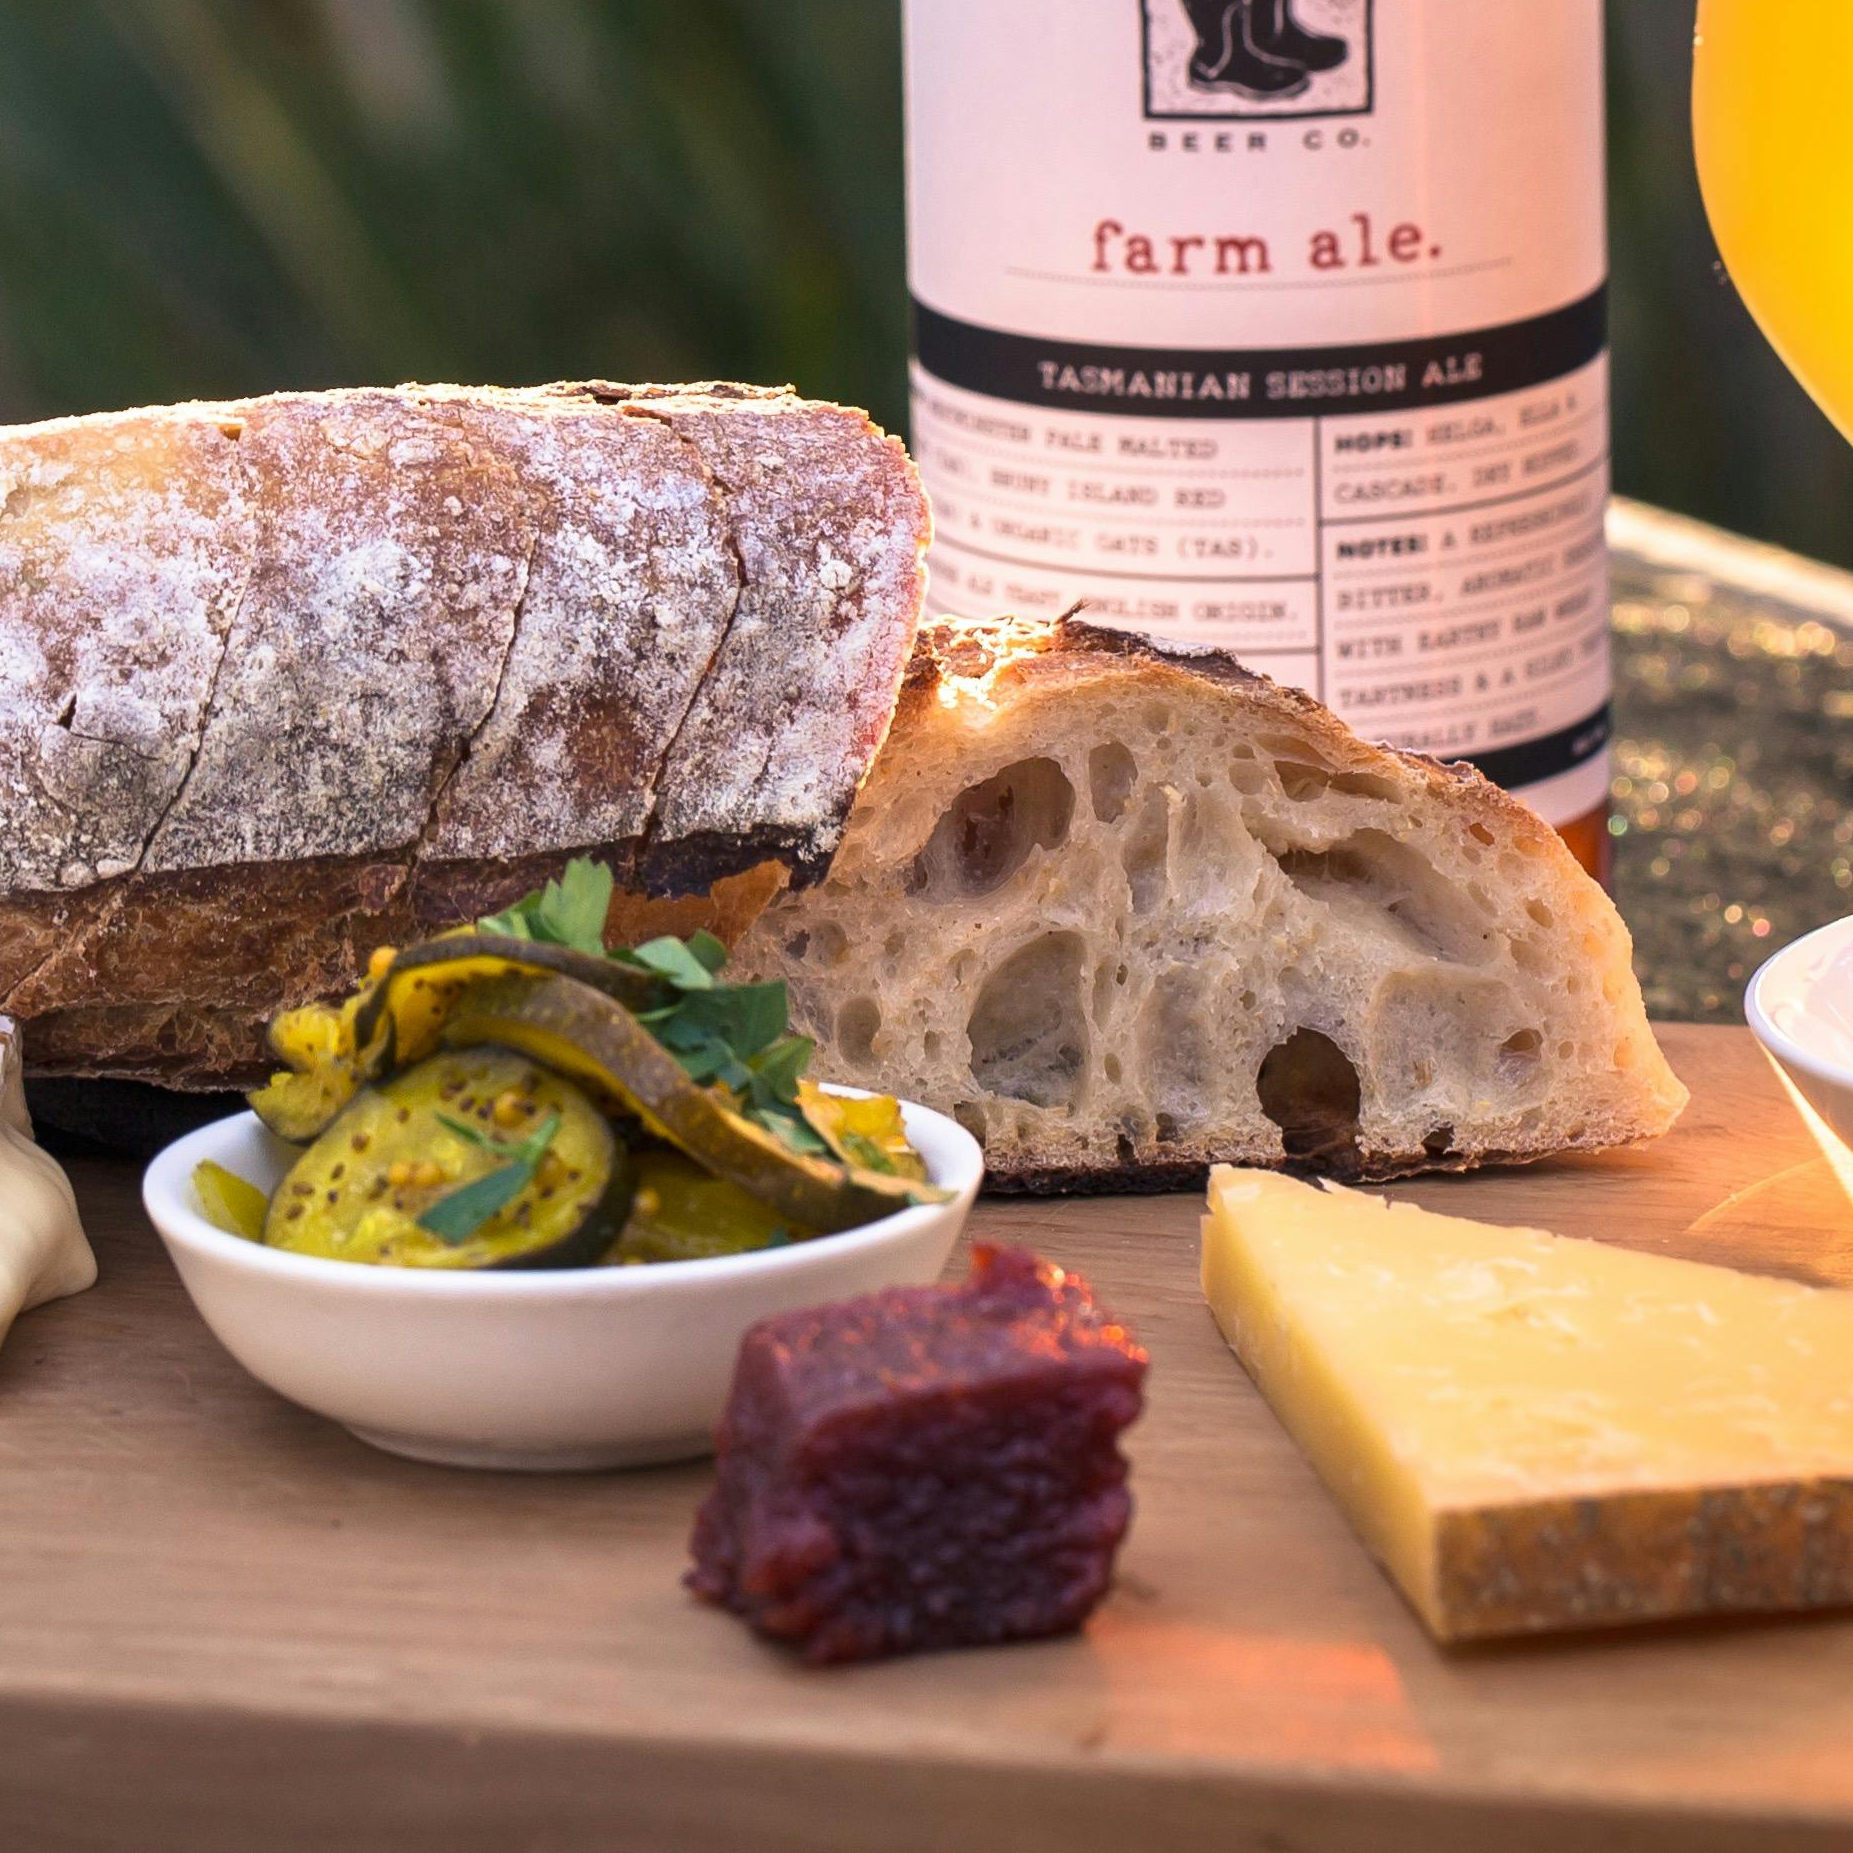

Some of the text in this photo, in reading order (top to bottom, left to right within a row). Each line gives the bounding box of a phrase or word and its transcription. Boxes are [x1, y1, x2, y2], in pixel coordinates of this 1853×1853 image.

[1149, 128, 1371, 151] BEER CO.
[1092, 212, 1441, 274] farm ale.
[1037, 352, 1483, 399] TASMANIAN SESSION ALE
[1045, 427, 1218, 459] PALE MALTED
[1335, 429, 1412, 453] HOPS:
[1068, 478, 1158, 506] ISLAND
[1337, 636, 1402, 660] WITH
